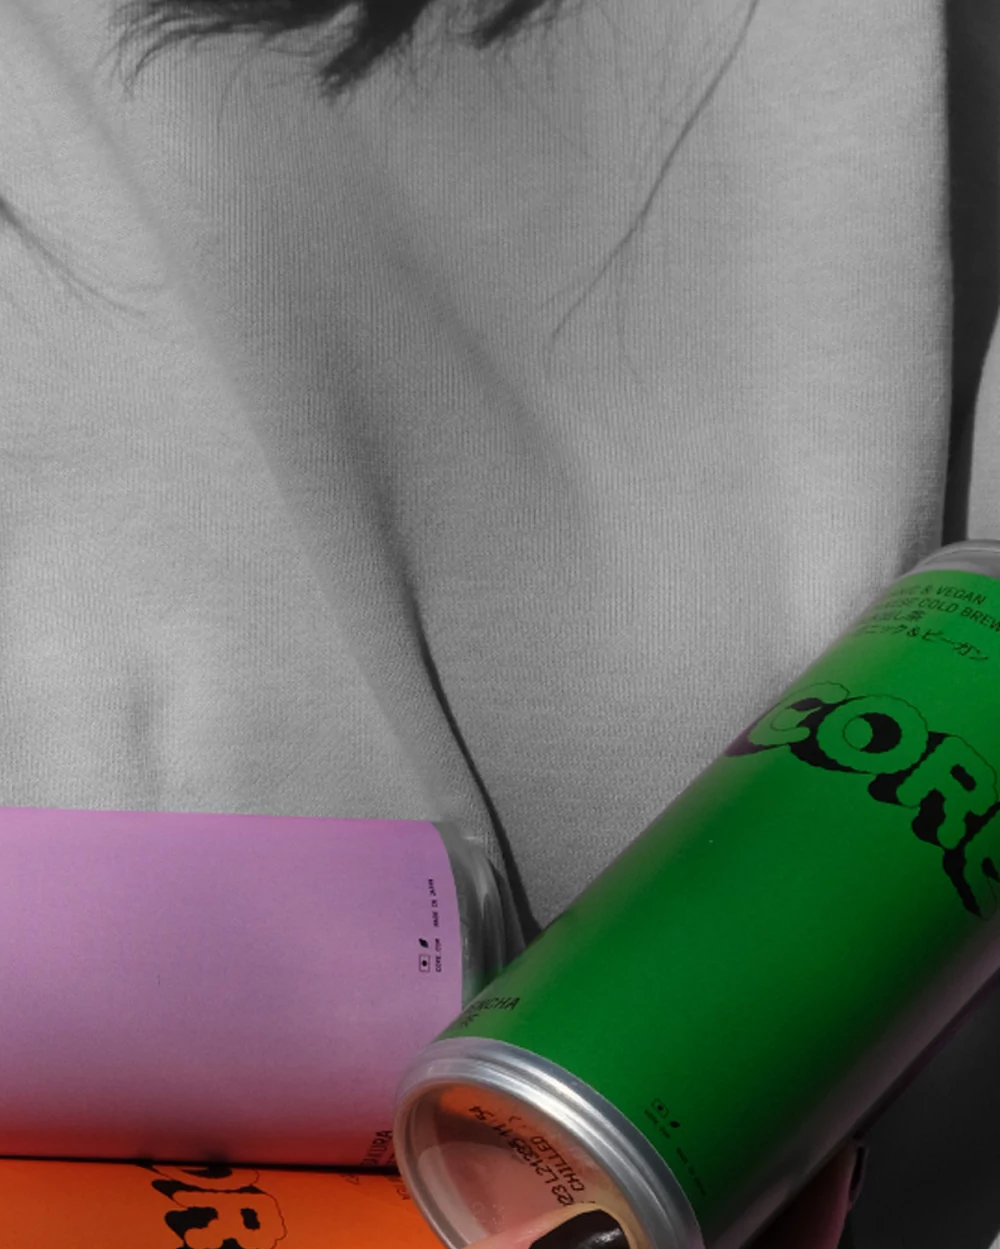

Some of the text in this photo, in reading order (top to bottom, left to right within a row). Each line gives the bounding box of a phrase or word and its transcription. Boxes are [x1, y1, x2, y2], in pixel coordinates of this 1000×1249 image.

[936, 585, 987, 606] VEGAN
[918, 599, 959, 614] COLD
[531, 1136, 586, 1191] CHILLED
